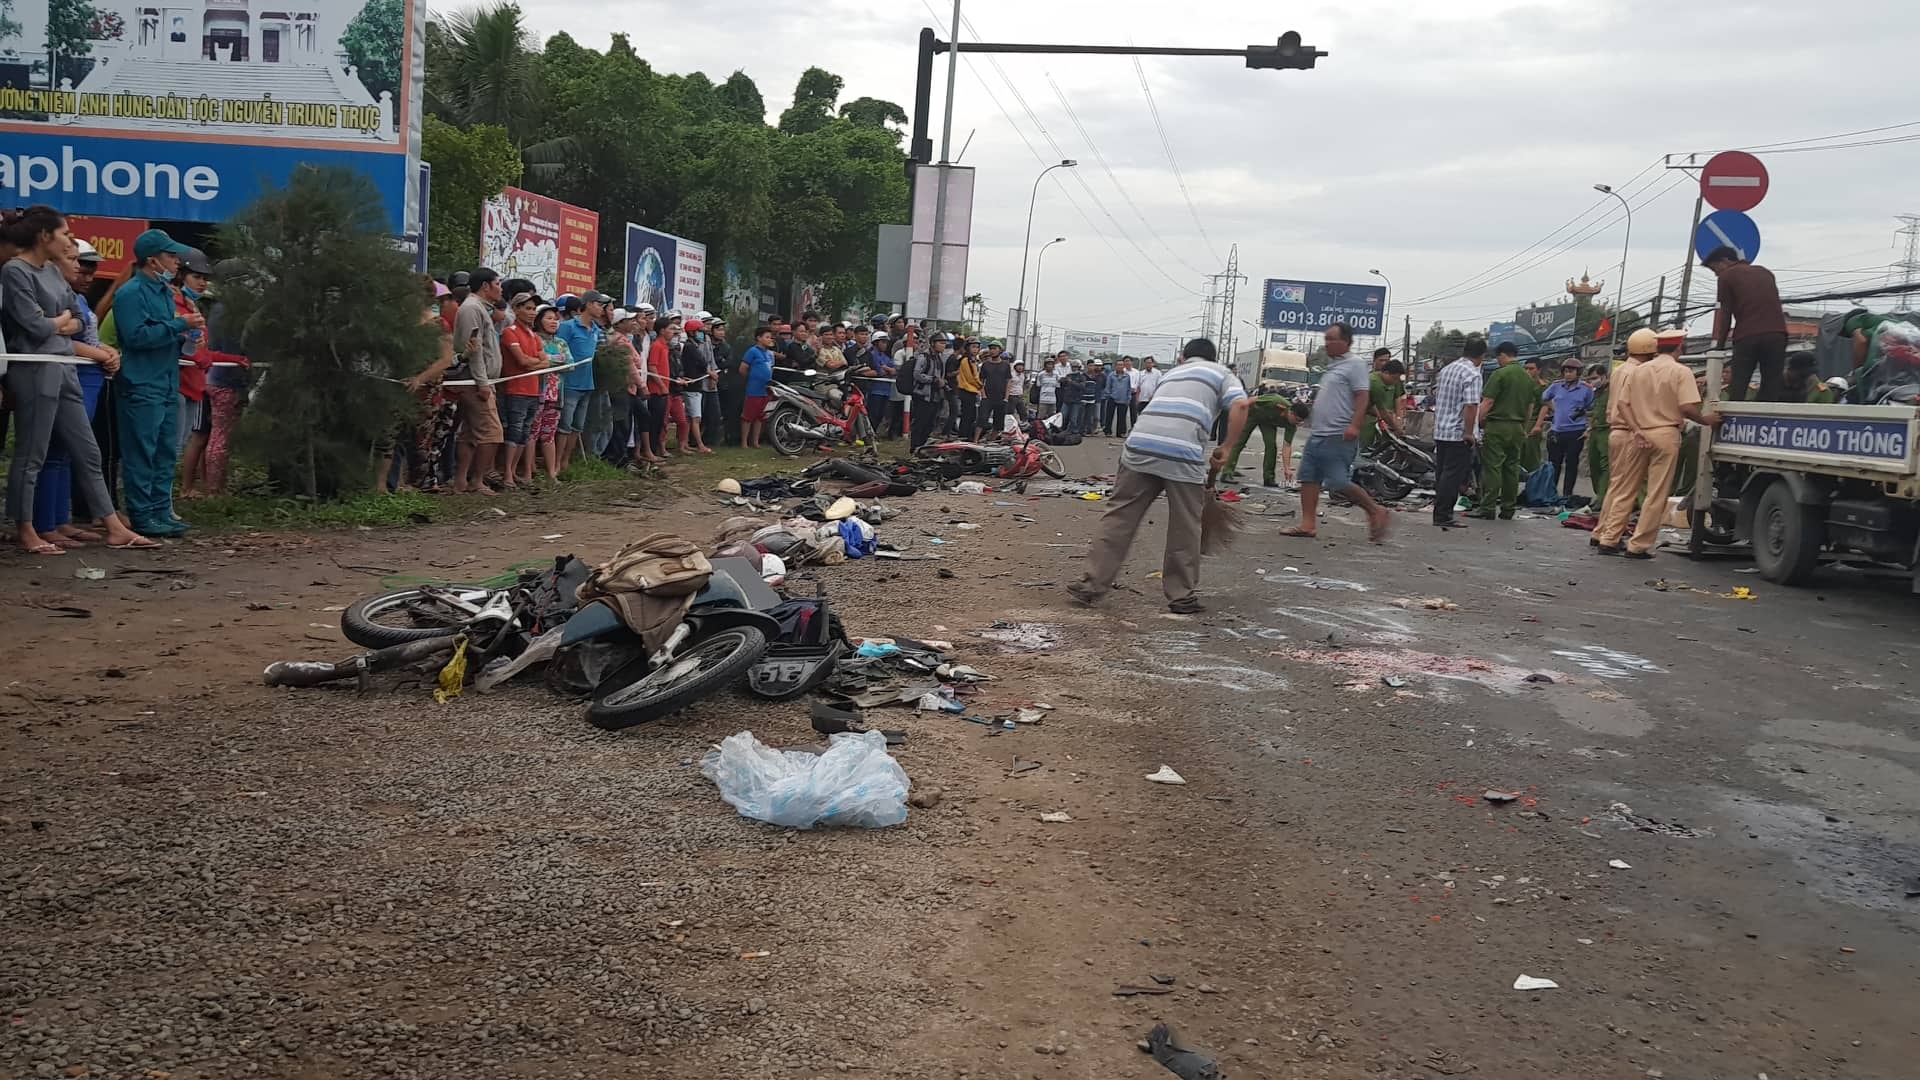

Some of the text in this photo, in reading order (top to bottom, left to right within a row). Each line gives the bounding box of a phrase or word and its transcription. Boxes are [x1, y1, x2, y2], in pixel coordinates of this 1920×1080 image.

[37, 87, 77, 117] NIỆM
[79, 92, 110, 116] ANH
[112, 90, 152, 118] HÙNG
[156, 91, 187, 119] DÂN
[190, 93, 218, 126] TỘC
[222, 92, 282, 124] NGUYỄN
[286, 102, 337, 128] TRUNG
[340, 104, 380, 134] TRỰC
[1720, 417, 1904, 456] CẢNH SÁT GIAO THÔNG
